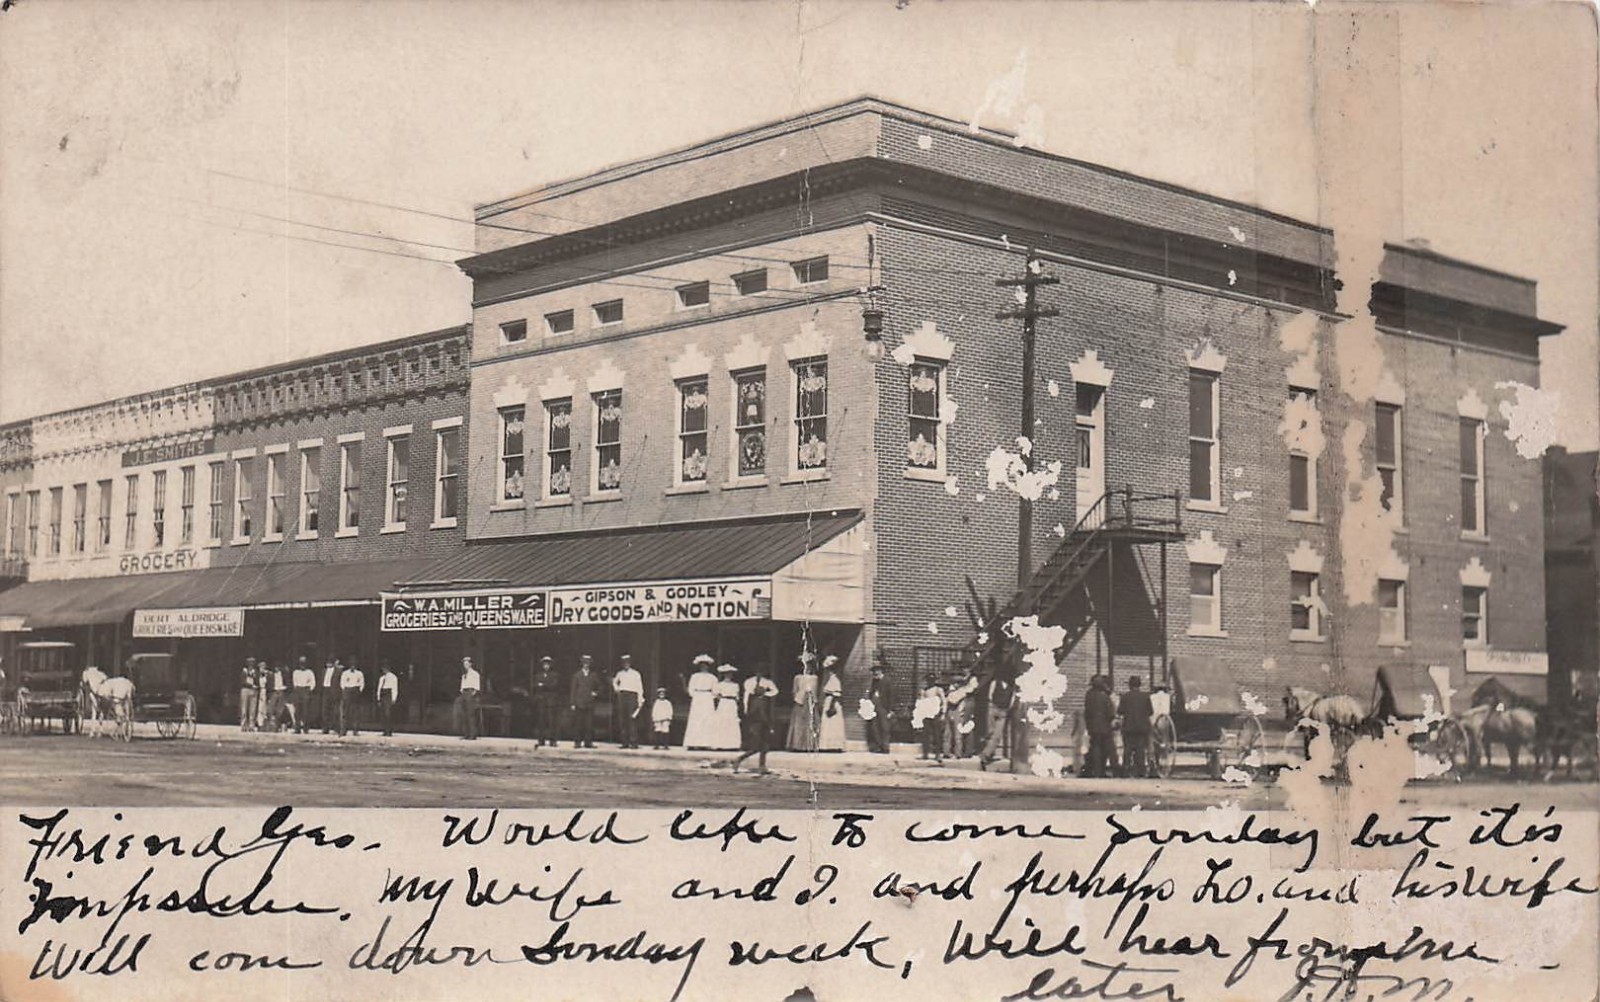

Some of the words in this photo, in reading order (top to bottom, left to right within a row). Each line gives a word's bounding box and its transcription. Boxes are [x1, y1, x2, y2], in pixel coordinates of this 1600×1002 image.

[119, 551, 197, 573] GROCERY
[585, 589, 636, 604] GIPSON
[644, 588, 656, 601] &
[666, 585, 728, 600] GODLEY
[385, 611, 447, 628] GROCERIES
[464, 608, 545, 629] QUEENSWARE
[551, 597, 585, 624] DRY
[588, 604, 645, 622] GOODS
[648, 600, 673, 618] AND
[670, 806, 797, 852] like
[905, 821, 1085, 843] come
[1350, 812, 1451, 848] but
[671, 856, 795, 901] and
[873, 861, 975, 902] and
[990, 844, 1175, 939] perhaps
[1120, 902, 1231, 955] hear
